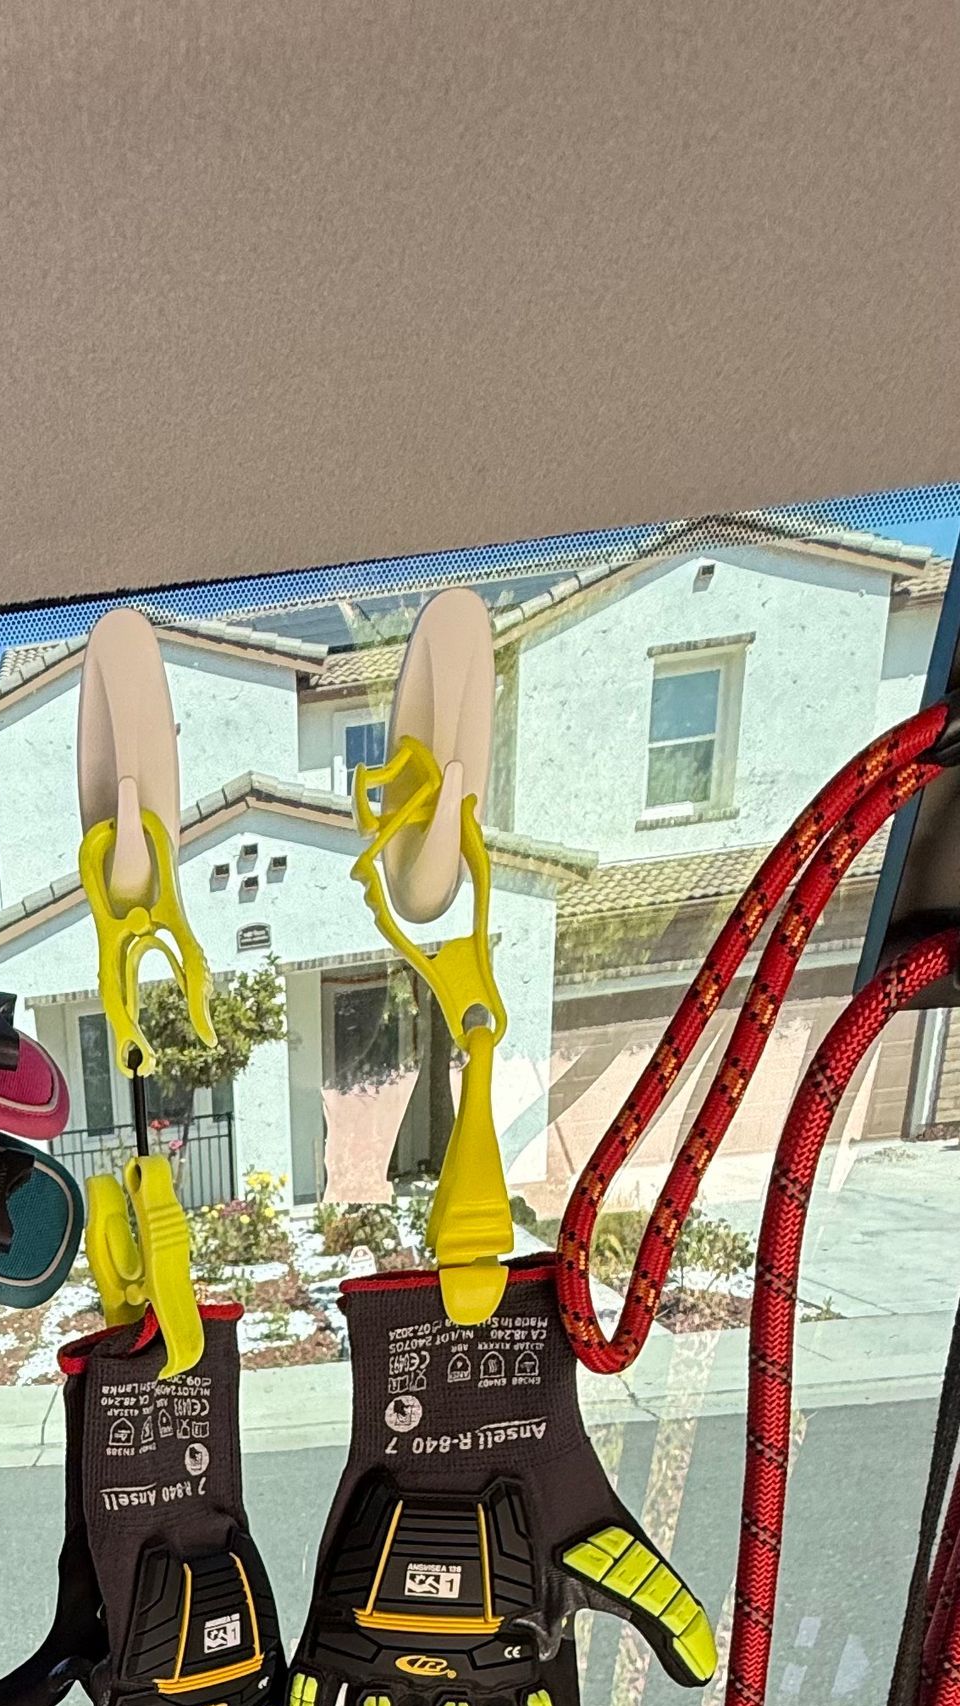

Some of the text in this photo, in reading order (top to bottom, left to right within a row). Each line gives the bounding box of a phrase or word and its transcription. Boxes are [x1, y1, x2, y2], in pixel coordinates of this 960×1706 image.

[514, 1316, 548, 1328] Made
[388, 1323, 431, 1340] 07.2024
[530, 1329, 547, 1340] CA
[388, 1336, 432, 1354] 240705
[102, 1383, 138, 1396] Lanka
[100, 1396, 137, 1406] 48.240
[384, 1422, 547, 1454] Ansell R-840 7
[198, 1476, 206, 1496] 7
[102, 1489, 157, 1511] Ansell
[445, 1578, 454, 1592] 1
[231, 1628, 237, 1640] 1
[504, 1645, 522, 1659] CE
